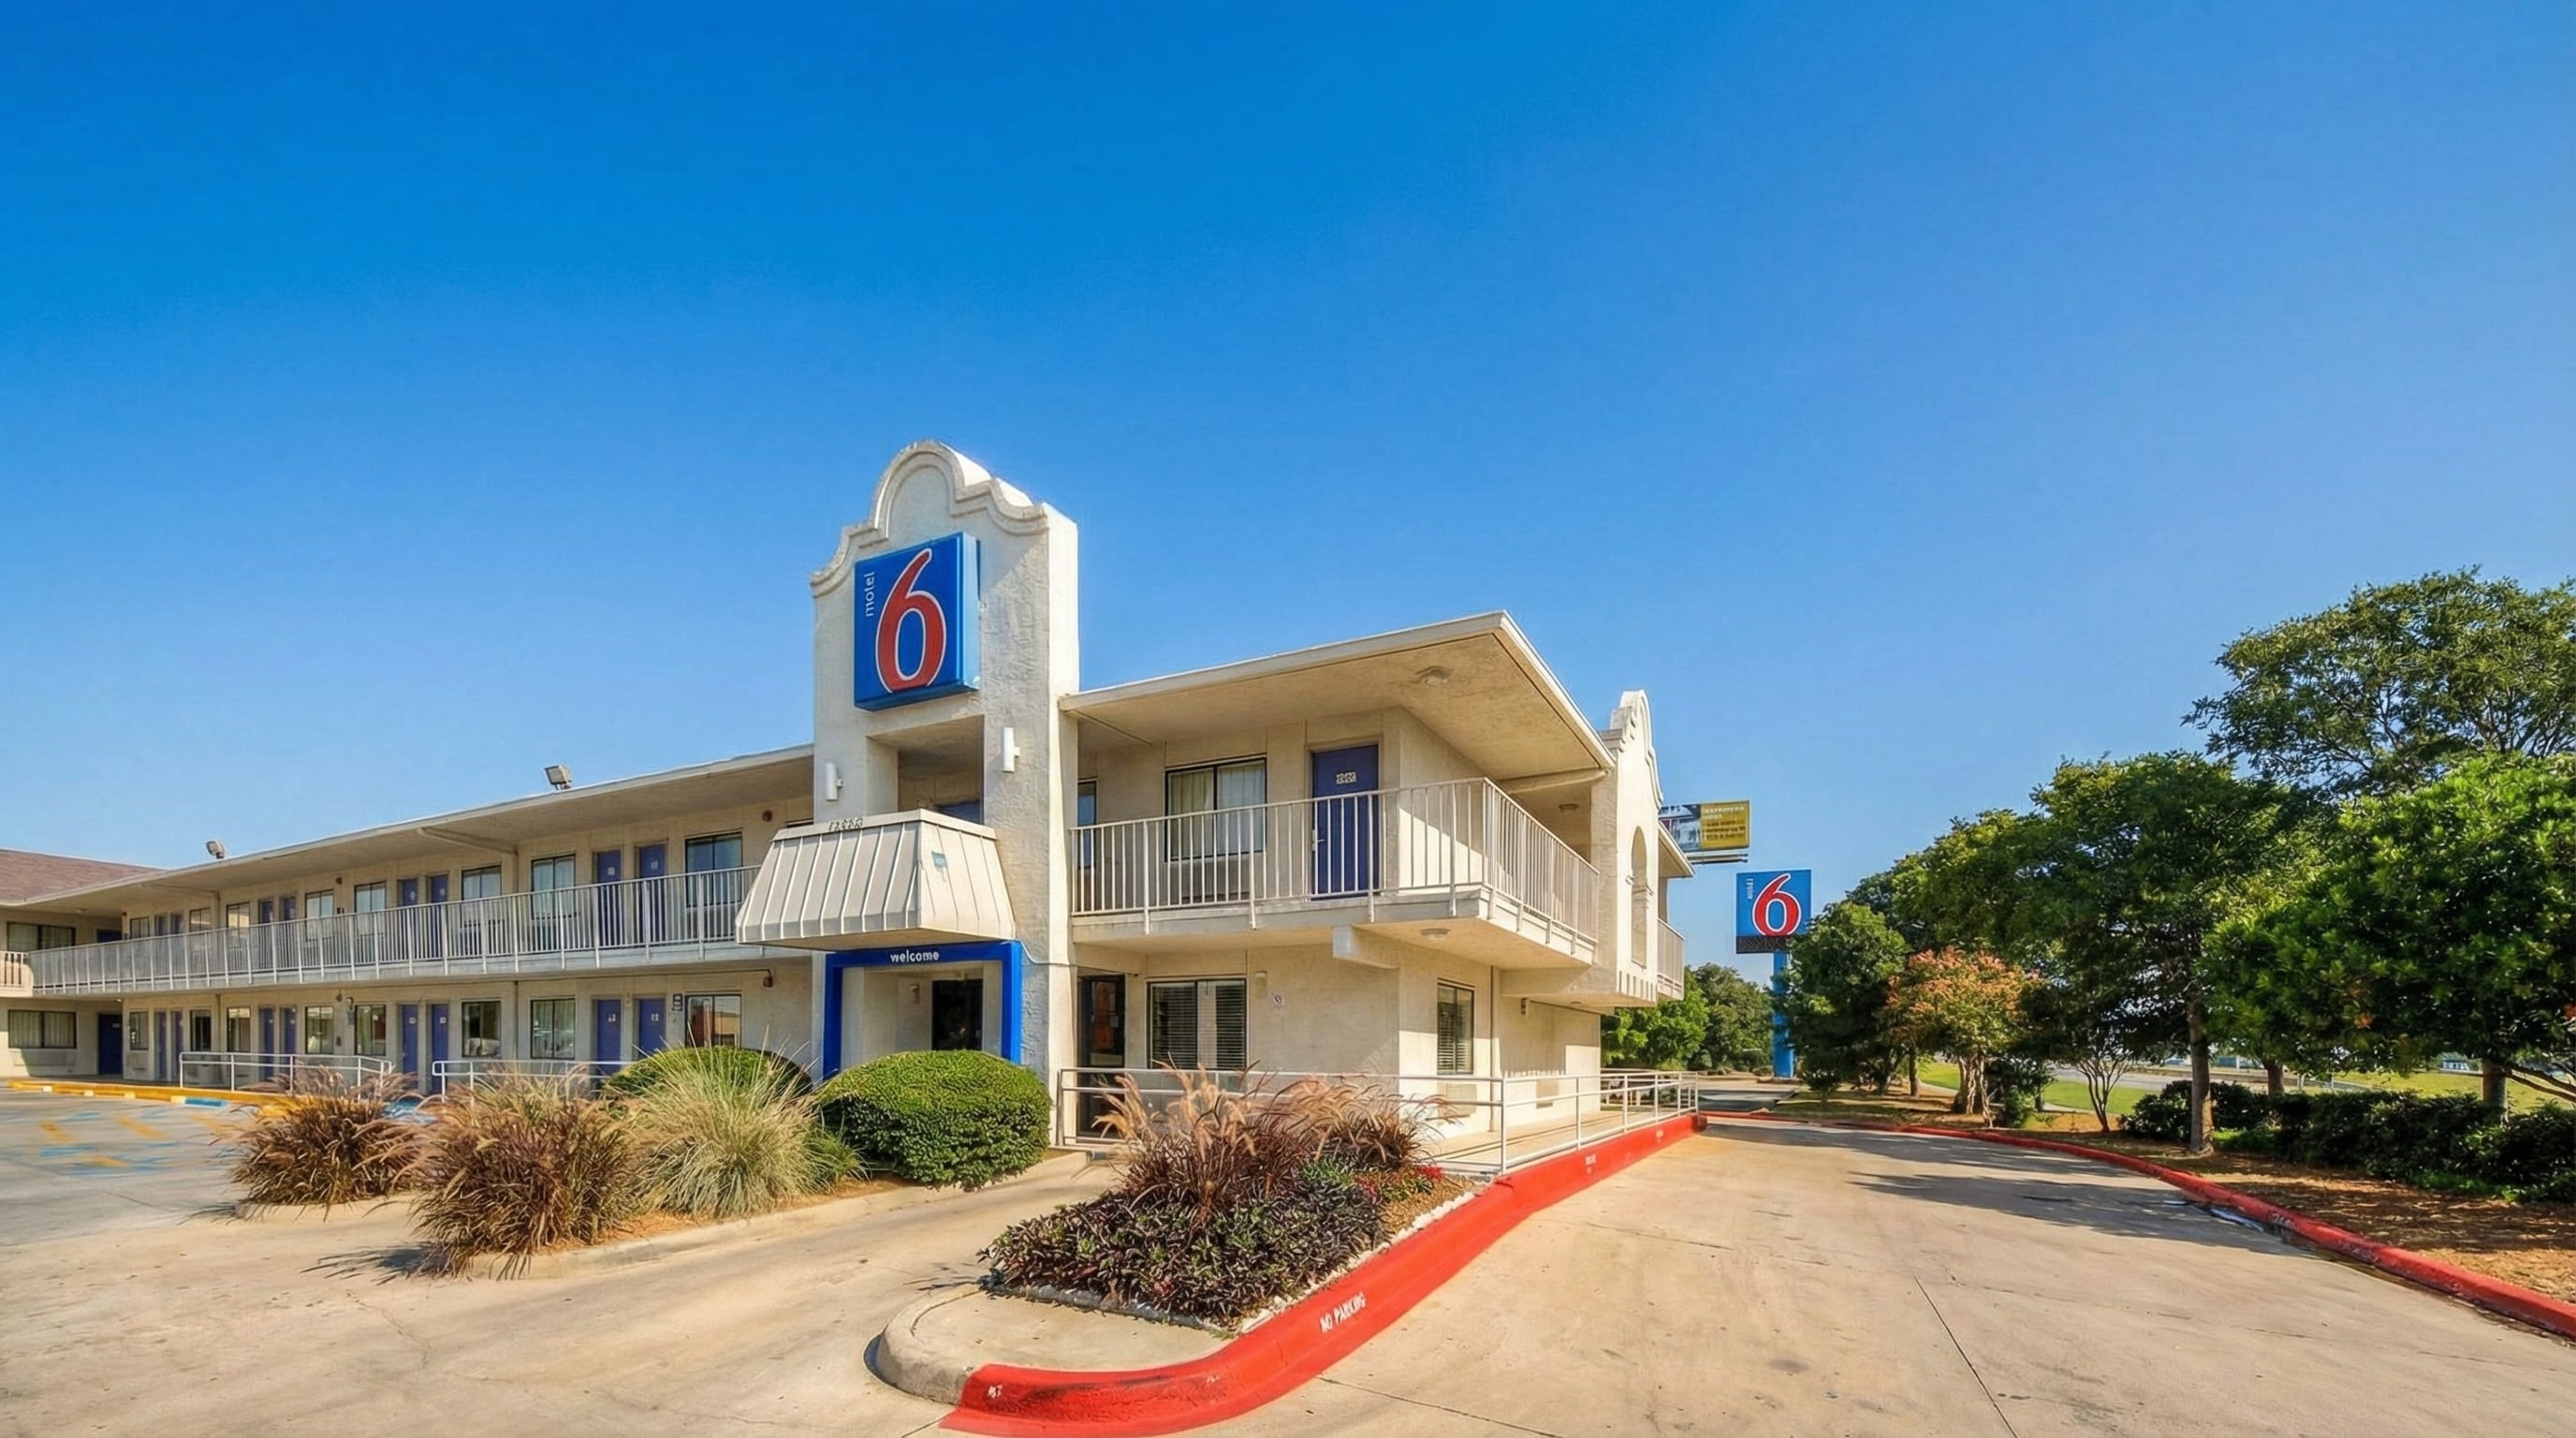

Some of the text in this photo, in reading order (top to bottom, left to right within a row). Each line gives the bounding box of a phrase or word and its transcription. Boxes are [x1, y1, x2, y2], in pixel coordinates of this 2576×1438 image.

[863, 548, 947, 694] motel 6
[1752, 873, 1802, 936] 6
[890, 948, 940, 962] welcome
